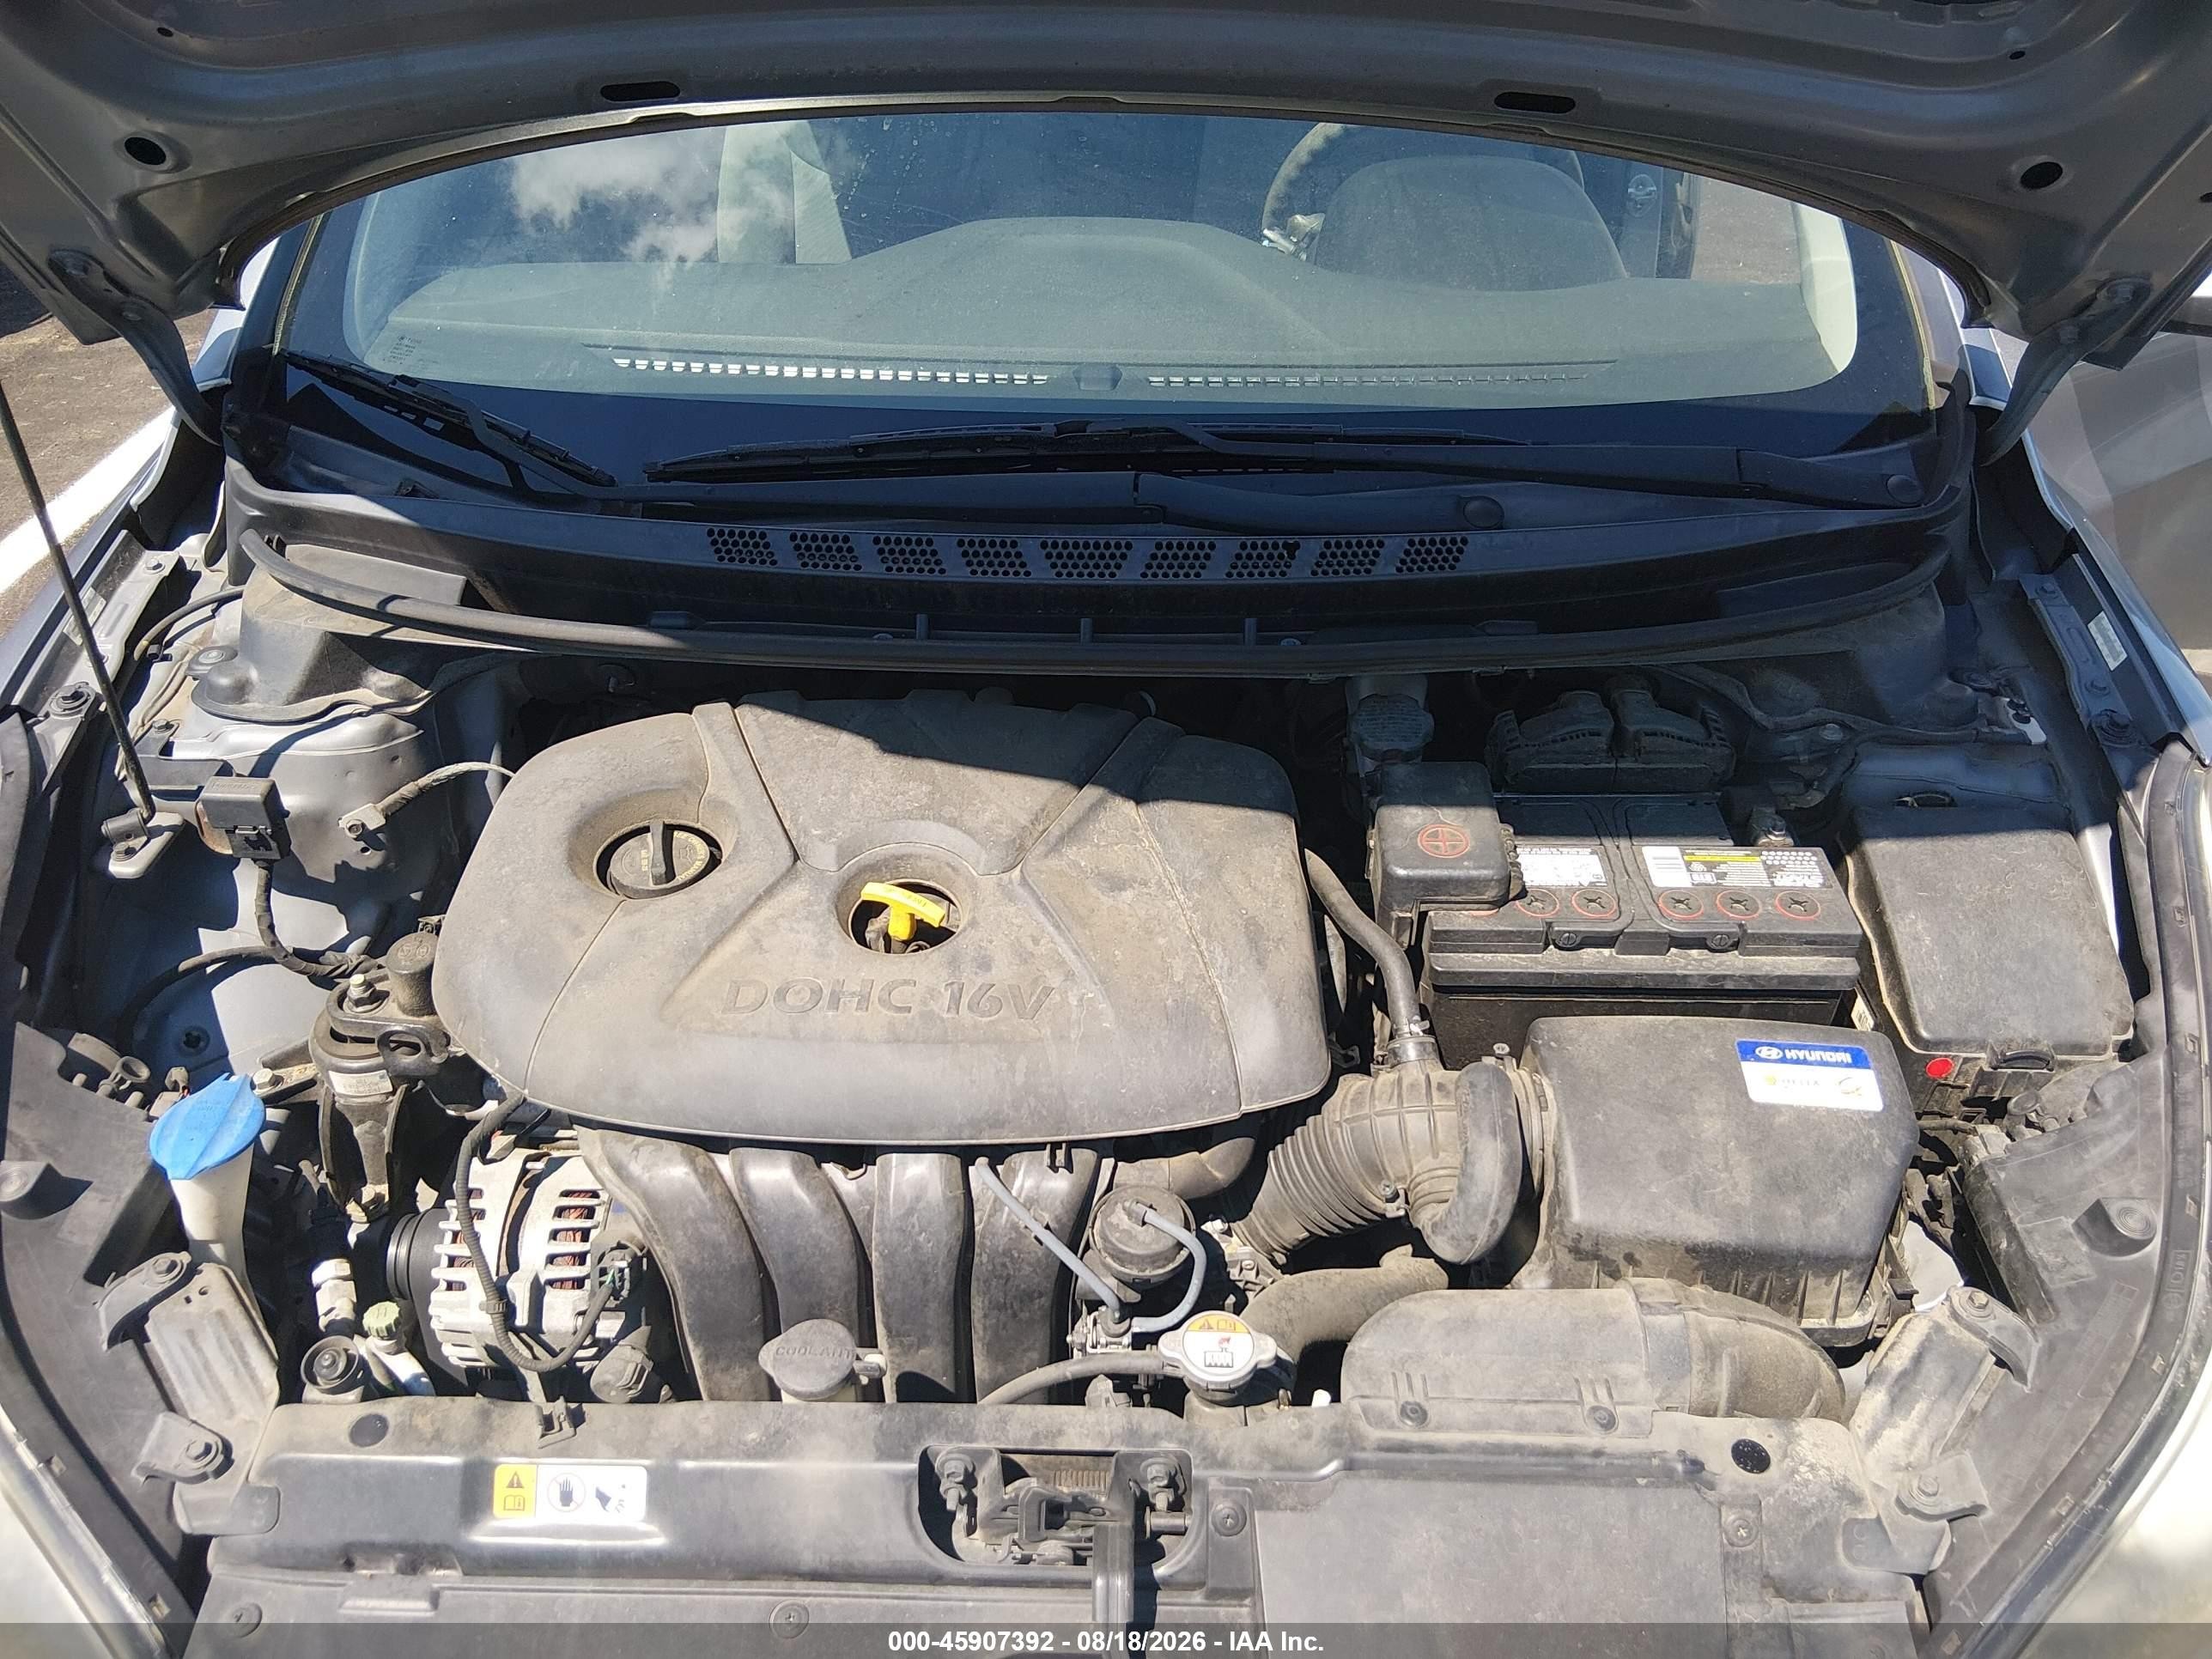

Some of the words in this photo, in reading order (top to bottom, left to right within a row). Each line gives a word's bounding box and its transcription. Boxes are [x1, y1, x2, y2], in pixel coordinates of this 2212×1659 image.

[720, 977, 917, 1015] DOHC
[943, 980, 1056, 1020] 16V
[1784, 1048, 1853, 1064] HYUNDAI
